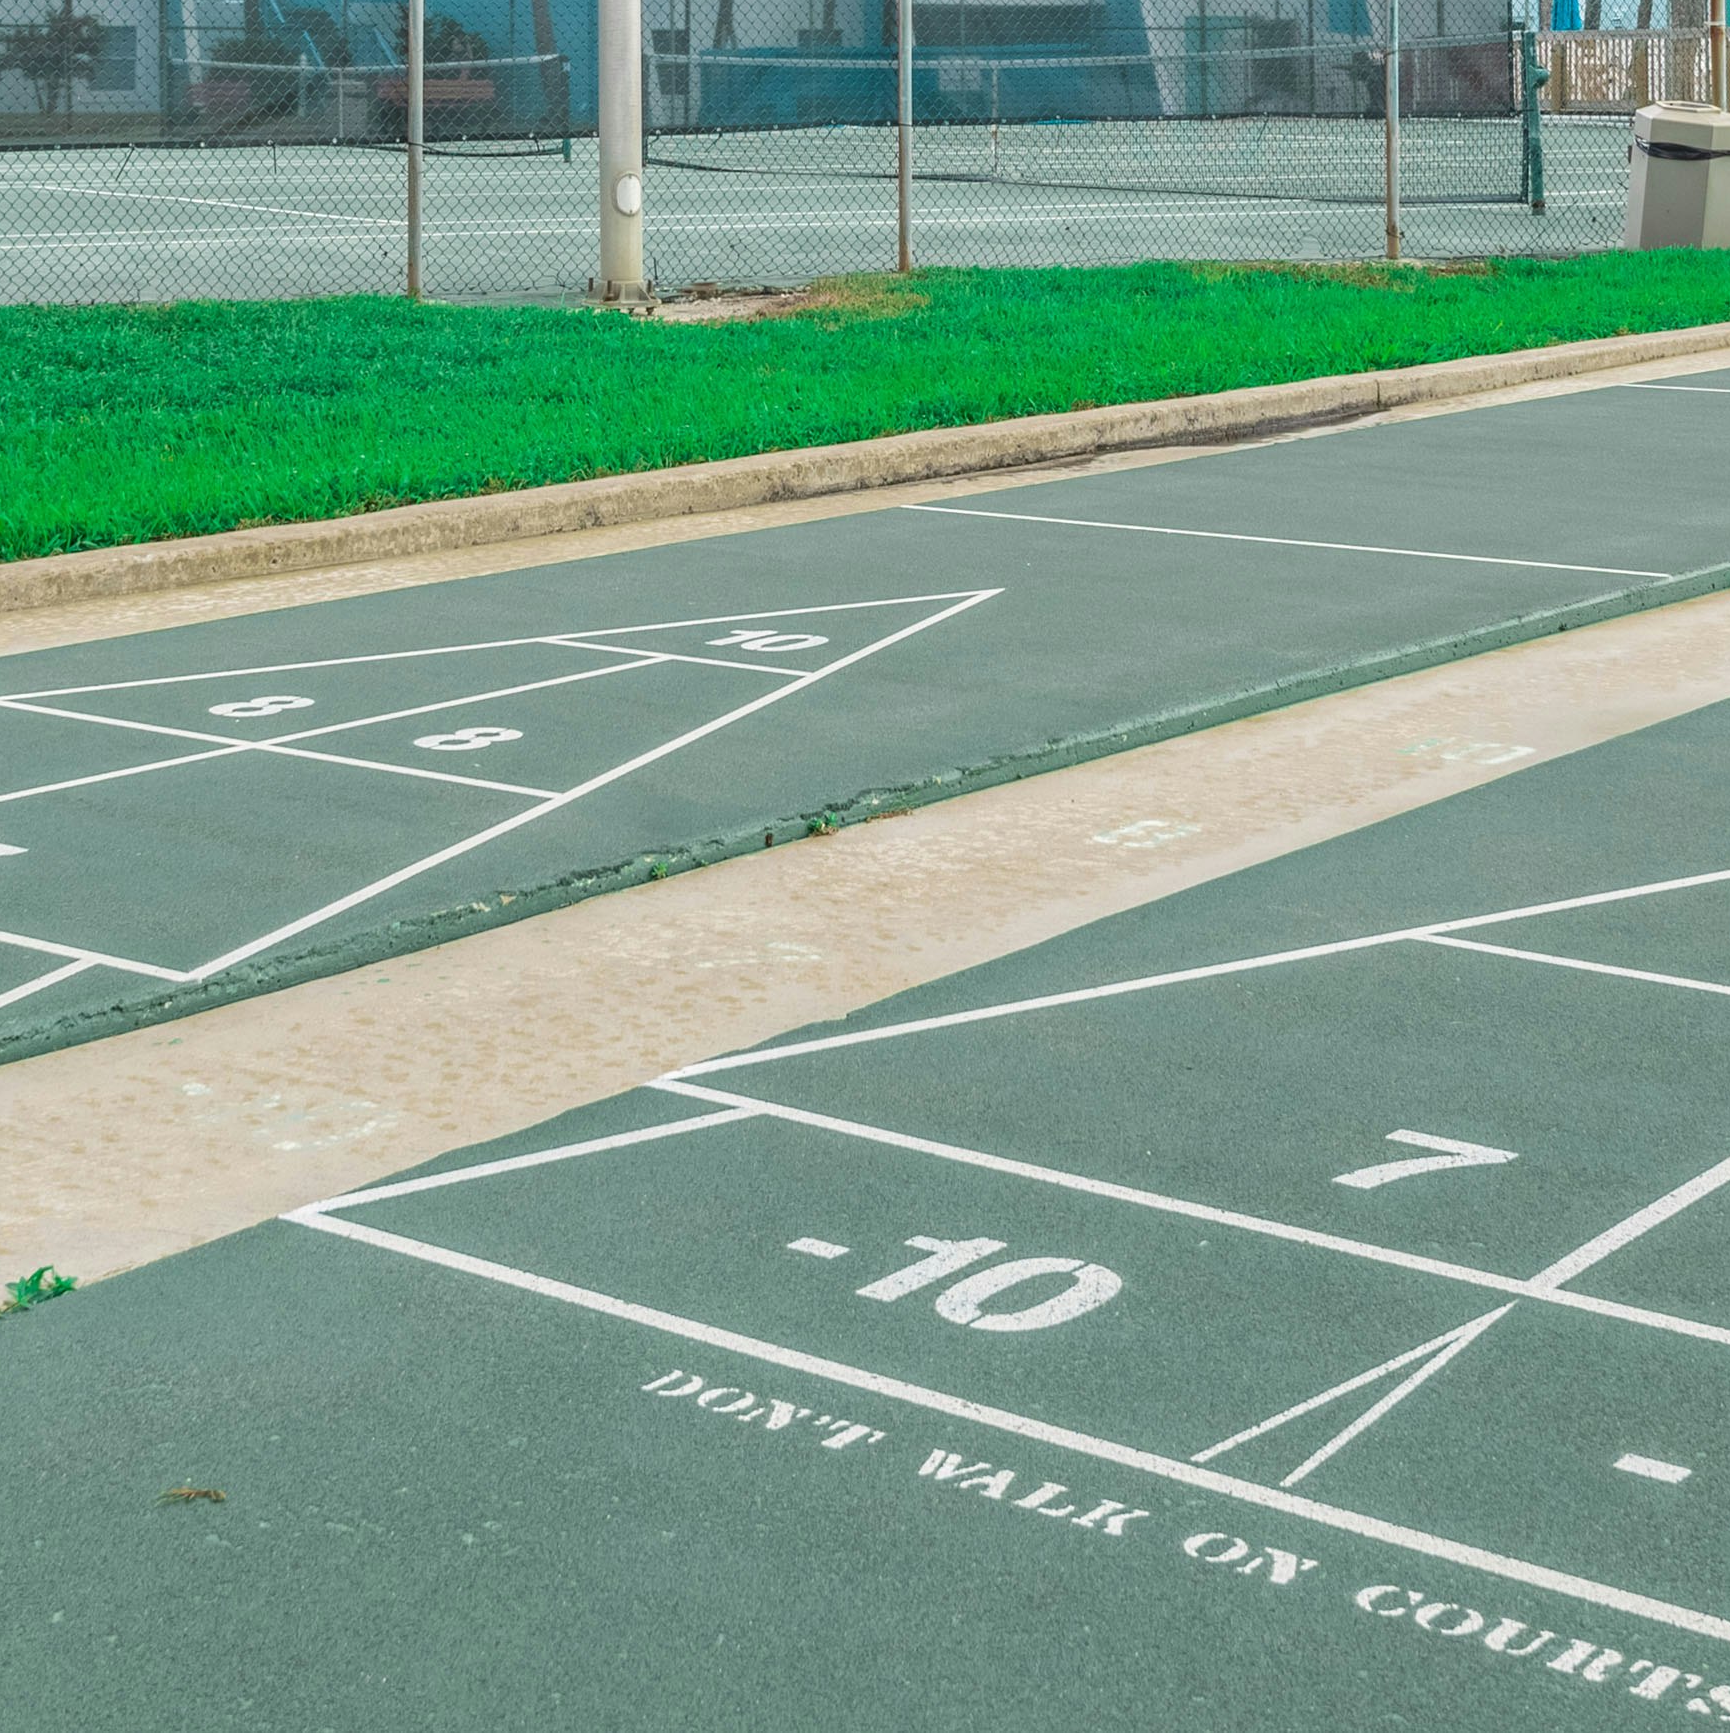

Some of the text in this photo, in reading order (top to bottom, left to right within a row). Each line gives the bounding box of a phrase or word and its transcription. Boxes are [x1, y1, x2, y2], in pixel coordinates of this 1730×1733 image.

[707, 628, 830, 653] 10
[208, 695, 315, 718] 8
[413, 726, 523, 751] 8
[1332, 1128, 1519, 1189] 7
[786, 1235, 1123, 1331] -10
[642, 1368, 885, 1451] DON'T
[916, 1447, 1152, 1536] WALK
[1182, 1532, 1319, 1585] ON
